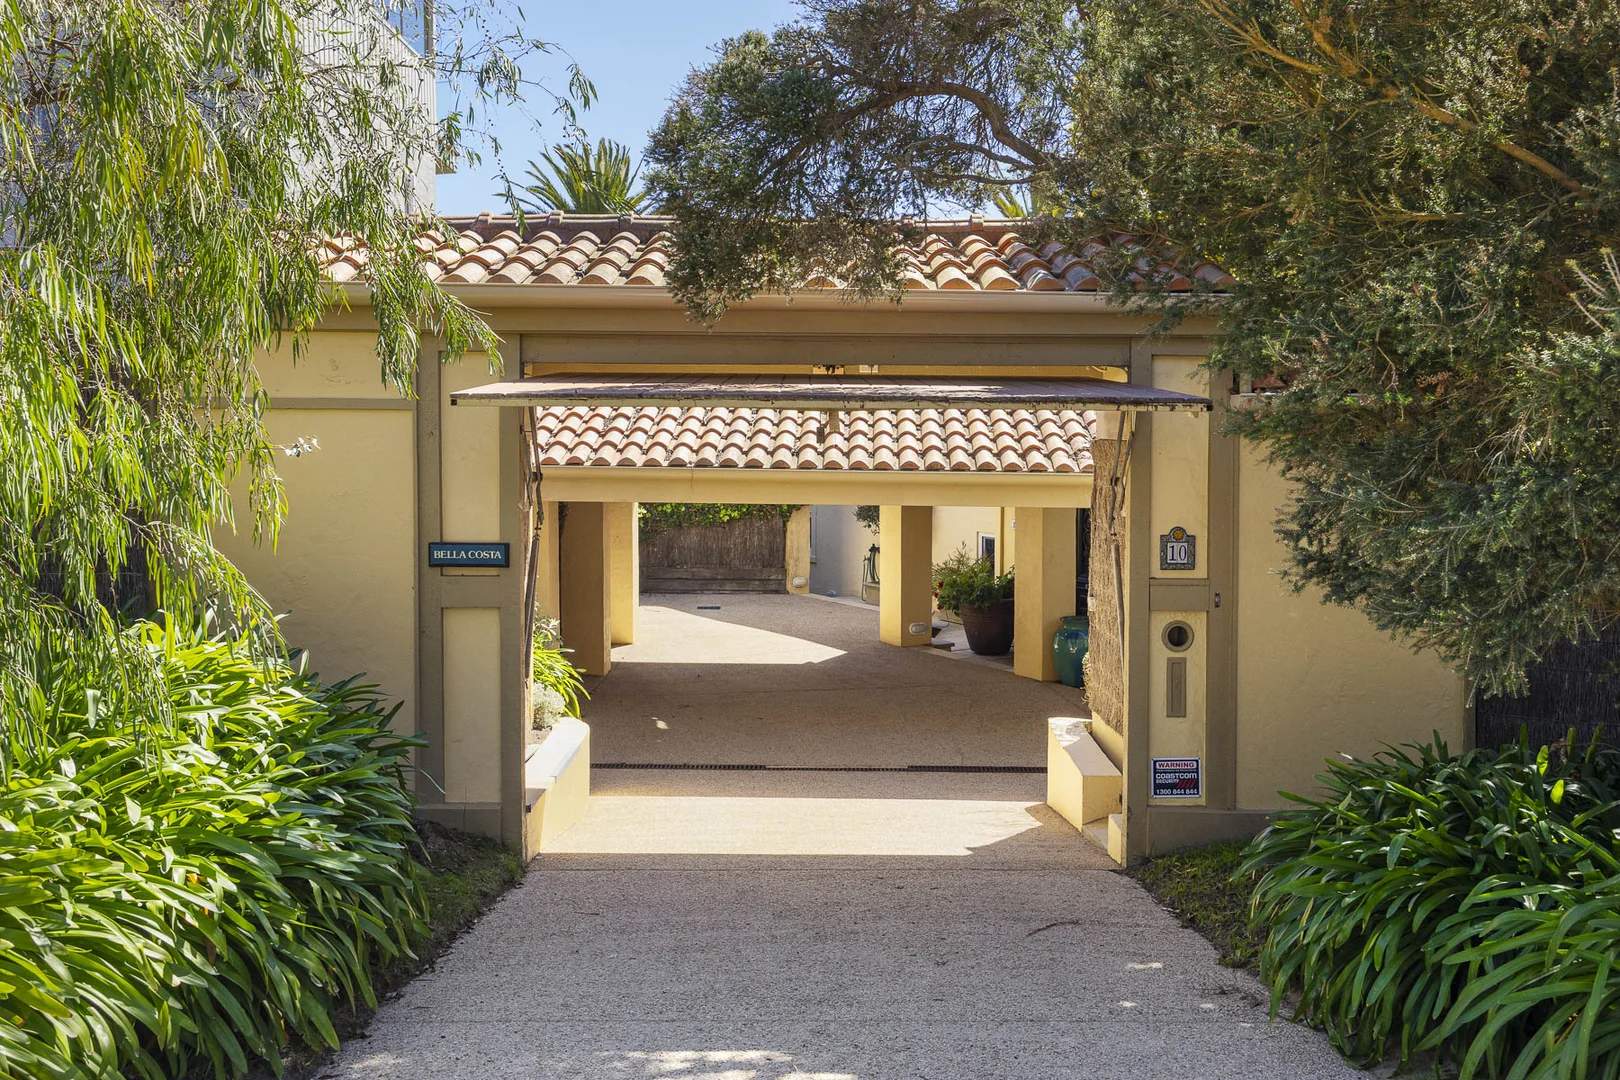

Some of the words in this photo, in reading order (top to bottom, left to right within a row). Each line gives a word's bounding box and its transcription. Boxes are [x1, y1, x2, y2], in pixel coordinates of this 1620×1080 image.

[433, 550, 467, 559] BELLA
[468, 550, 502, 559] COSTA
[1169, 545, 1187, 561] 10
